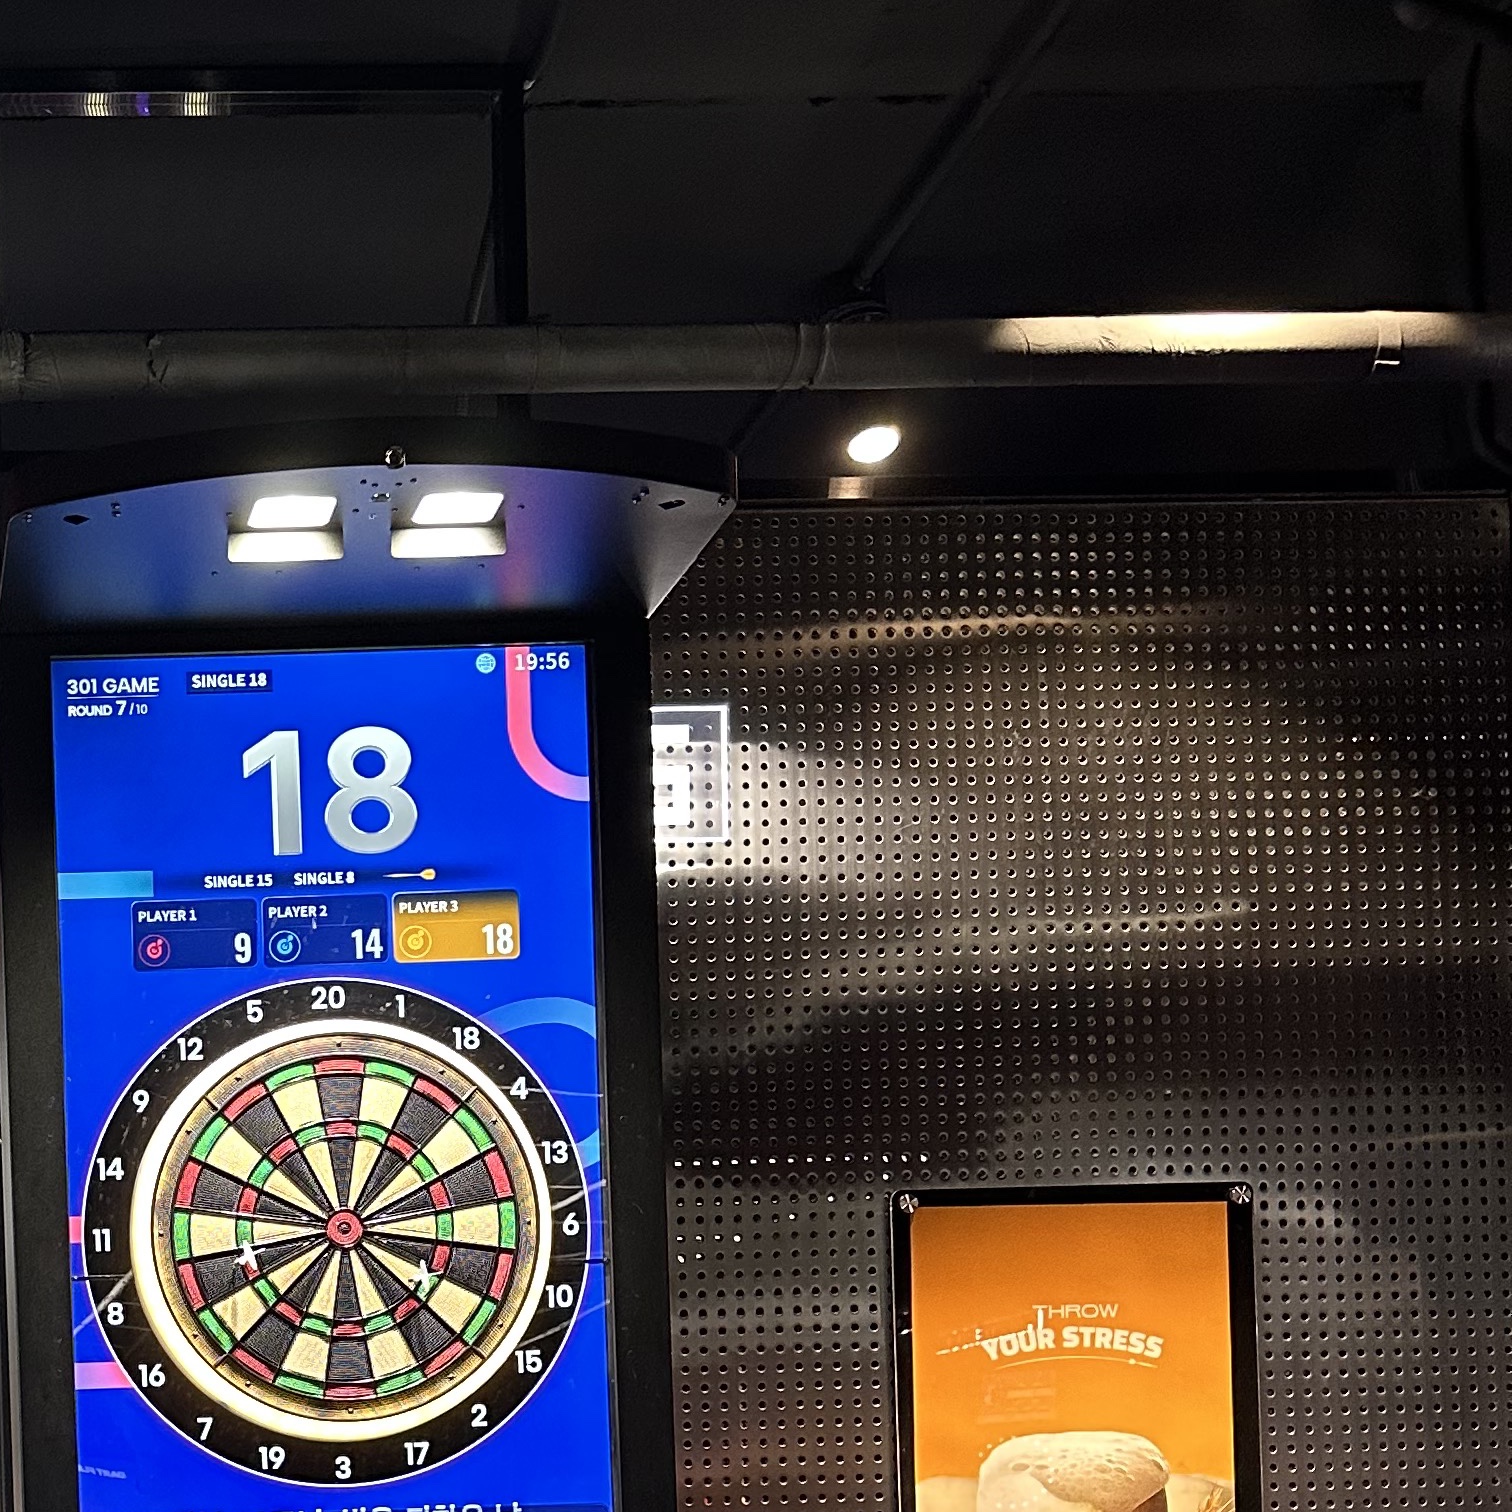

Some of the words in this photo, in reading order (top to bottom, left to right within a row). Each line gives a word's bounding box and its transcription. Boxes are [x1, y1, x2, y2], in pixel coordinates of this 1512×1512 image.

[514, 652, 570, 671] 19:56
[67, 678, 97, 695] 301
[102, 677, 160, 694] GAME
[191, 674, 246, 689] SINGLE
[248, 673, 267, 687] 18
[67, 705, 113, 717] ROUND
[242, 725, 418, 856] 18
[204, 875, 254, 889] SINGLE
[256, 873, 273, 887] 15
[293, 872, 344, 886] SINGLE
[345, 871, 355, 884] 8
[137, 909, 186, 923] PLAYER
[189, 909, 197, 921] 1
[268, 906, 317, 919] PLAYER
[318, 905, 328, 917] 2
[399, 901, 448, 914] PLAYER
[449, 900, 459, 913] 3
[234, 932, 252, 964] 9
[351, 928, 384, 960] 14
[481, 923, 514, 955] 18
[311, 985, 346, 1010] 20
[395, 995, 406, 1018] 1
[246, 1000, 264, 1022] 5
[177, 1038, 204, 1061] 12
[453, 1027, 480, 1050] 18
[510, 1077, 528, 1100] 4
[133, 1090, 149, 1112] 9
[542, 1140, 569, 1163] 13
[97, 1158, 124, 1181] 14
[562, 1212, 580, 1235] 6
[92, 1230, 111, 1252] 11
[546, 1285, 574, 1308] 10
[106, 1303, 124, 1326] 8
[1032, 1303, 1119, 1319] THROW
[980, 1326, 1056, 1361] YOUR
[1062, 1325, 1165, 1359] STRESS
[515, 1350, 542, 1373] 15
[138, 1364, 166, 1387] 16
[471, 1404, 488, 1427] 2
[196, 1418, 213, 1440] 7
[258, 1446, 285, 1470] 19
[403, 1442, 430, 1465] 17
[334, 1456, 352, 1479] 3
